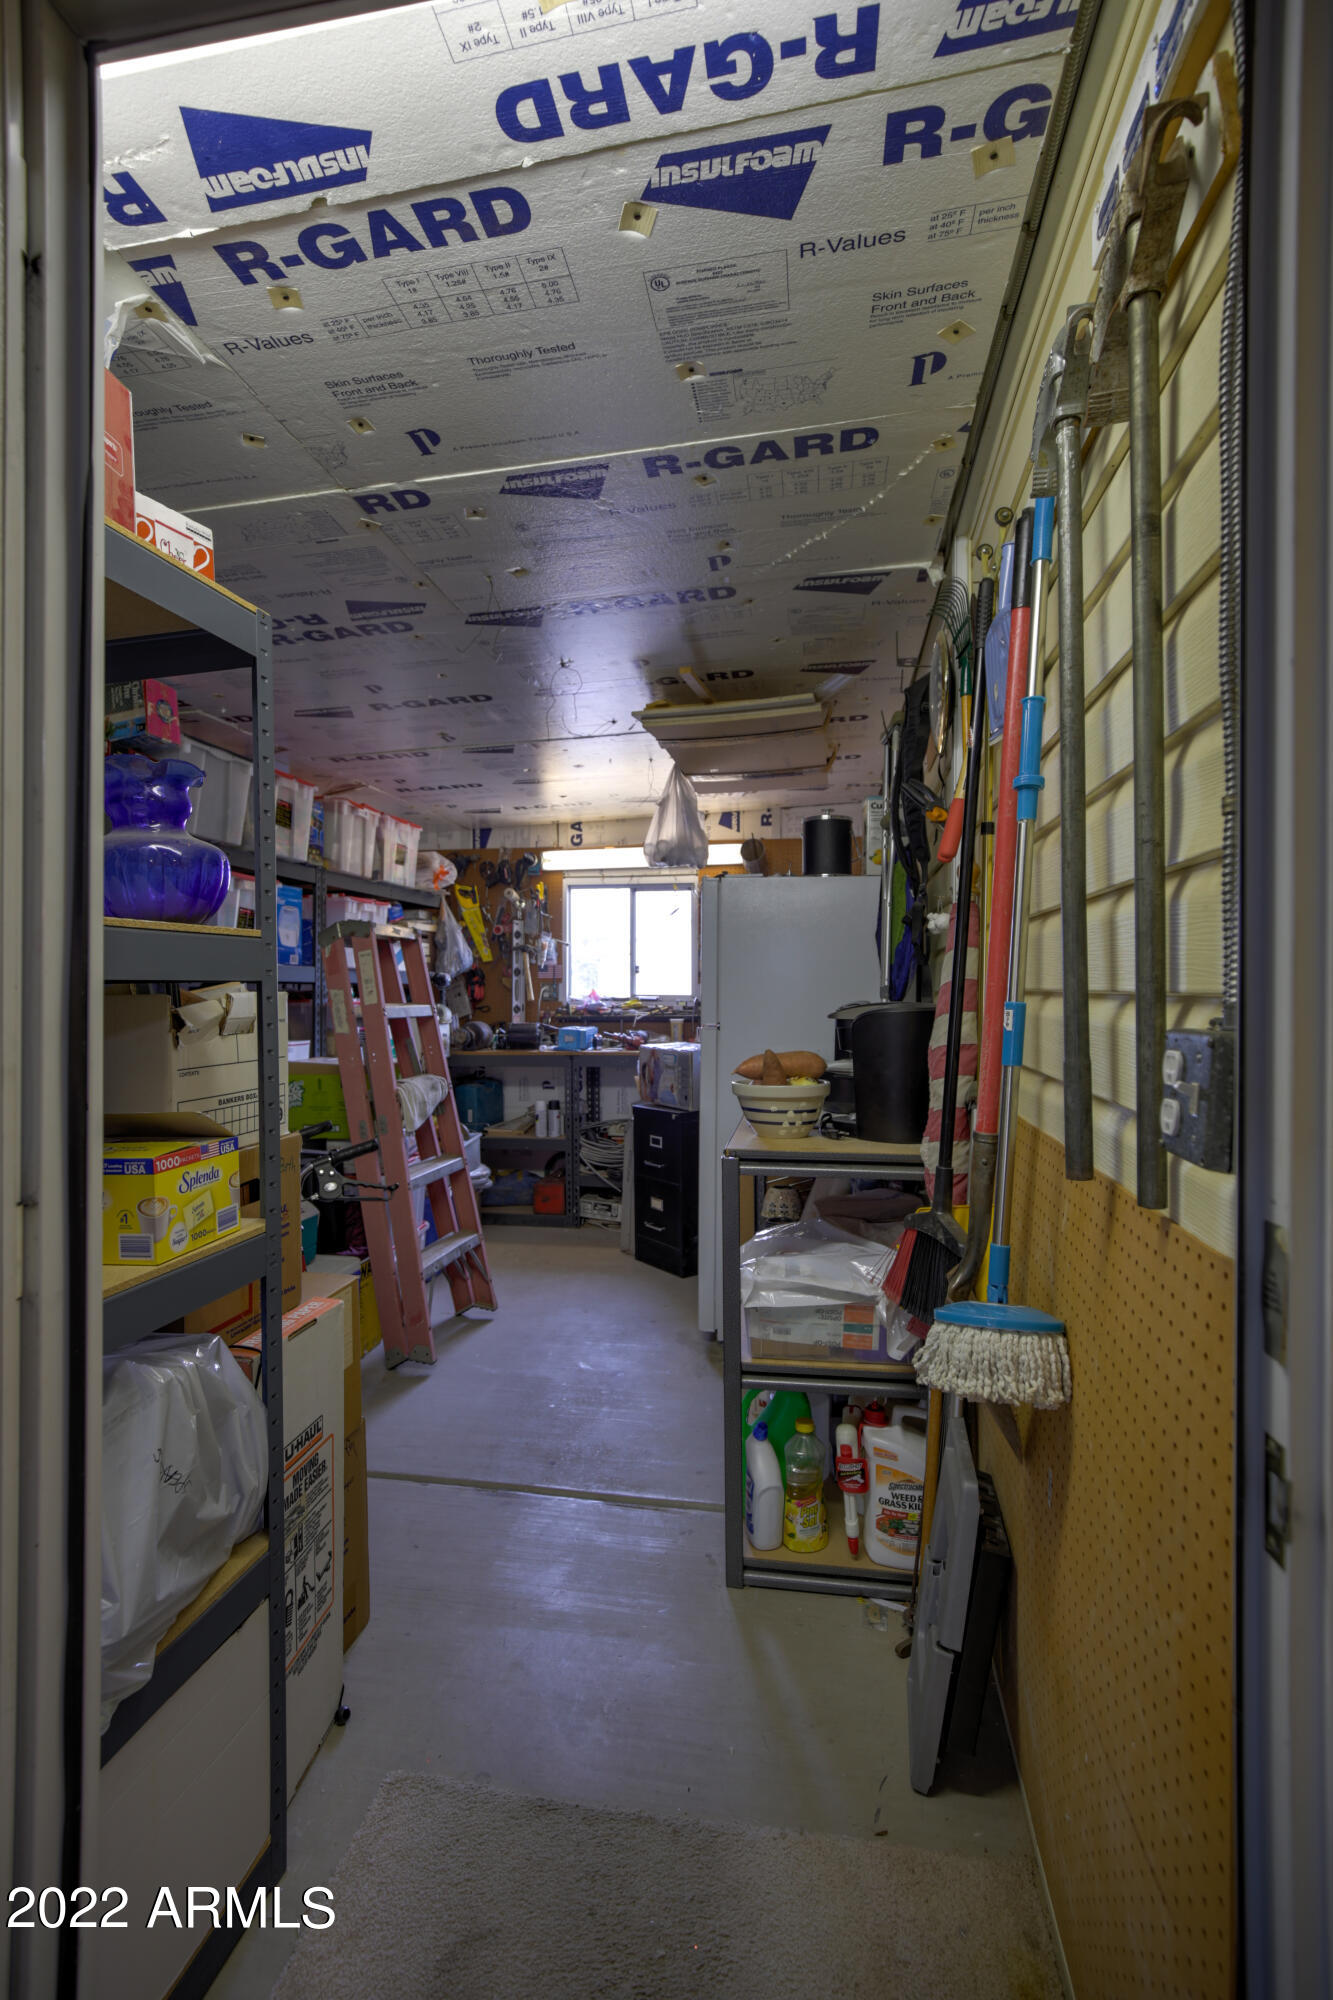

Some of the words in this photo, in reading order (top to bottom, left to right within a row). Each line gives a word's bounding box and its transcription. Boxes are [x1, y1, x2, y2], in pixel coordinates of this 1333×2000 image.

[577, 12, 595, 25] VIII
[598, 4, 625, 18] Type
[529, 20, 557, 35] Type
[474, 33, 500, 48] Type
[495, 3, 880, 143] R-GARD
[211, 187, 532, 285] R-GARD
[800, 230, 907, 259] R-Values
[872, 290, 902, 302] Skin
[906, 280, 969, 297] Surfaces
[871, 303, 907, 314] Front
[911, 295, 937, 308] and
[941, 290, 976, 303] Back
[223, 331, 315, 357] R-Values
[467, 346, 534, 366] Thoroughly
[536, 342, 576, 355] Tested
[325, 378, 350, 390] Skin
[352, 370, 404, 384] Surfaces
[332, 387, 364, 398] Front
[366, 382, 387, 394] and
[389, 378, 419, 389] Back
[643, 427, 880, 478] R-GARD
[218, 1094, 244, 1106] BANKERS
[220, 1143, 235, 1154] USA
[124, 1165, 146, 1174] USA
[156, 1156, 180, 1172] 1000
[179, 1166, 220, 1194] Splenda
[285, 1421, 322, 1461] U-HAUL
[293, 1452, 319, 1488] MOVING
[878, 1497, 907, 1509] GRASS
[891, 1492, 916, 1502] WEED
